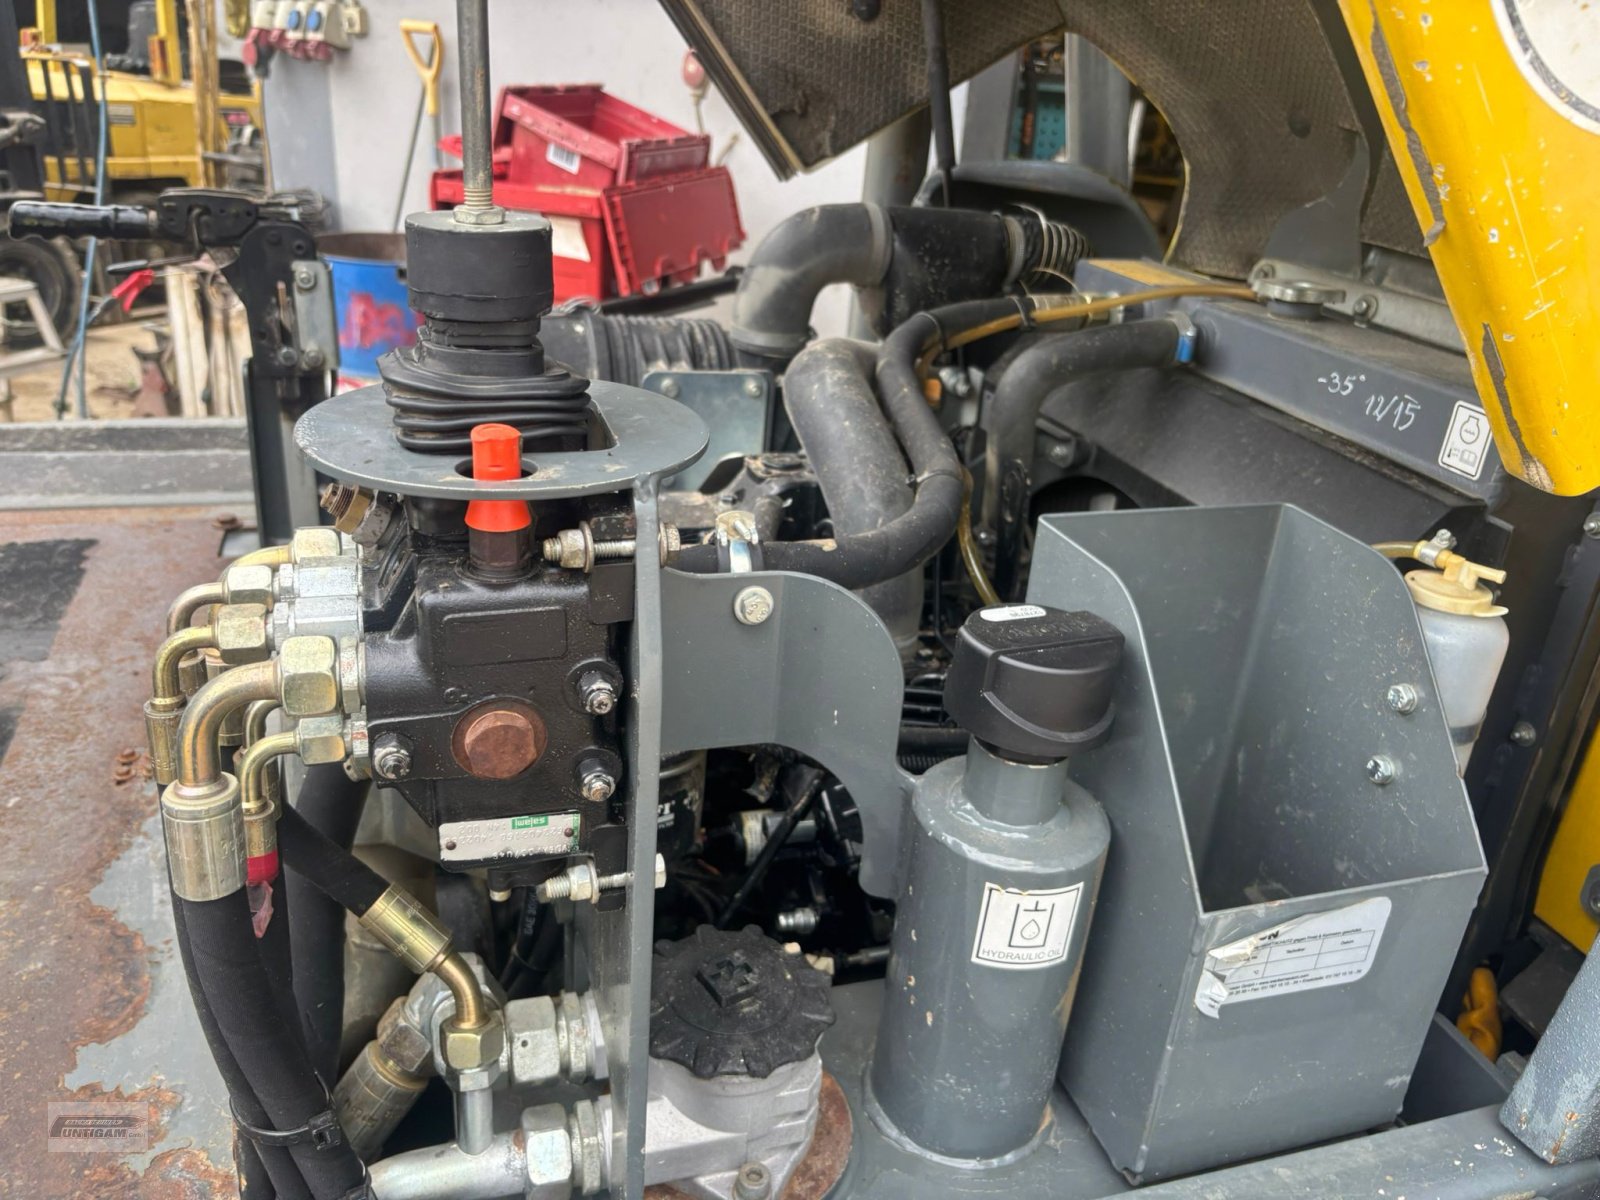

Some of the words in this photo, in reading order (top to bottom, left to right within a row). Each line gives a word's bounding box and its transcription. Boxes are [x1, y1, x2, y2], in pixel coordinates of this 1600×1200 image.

[1365, 393, 1421, 431] 12/15
[981, 948, 1045, 961] HYDRAULIC
[1047, 948, 1062, 958] OIL
